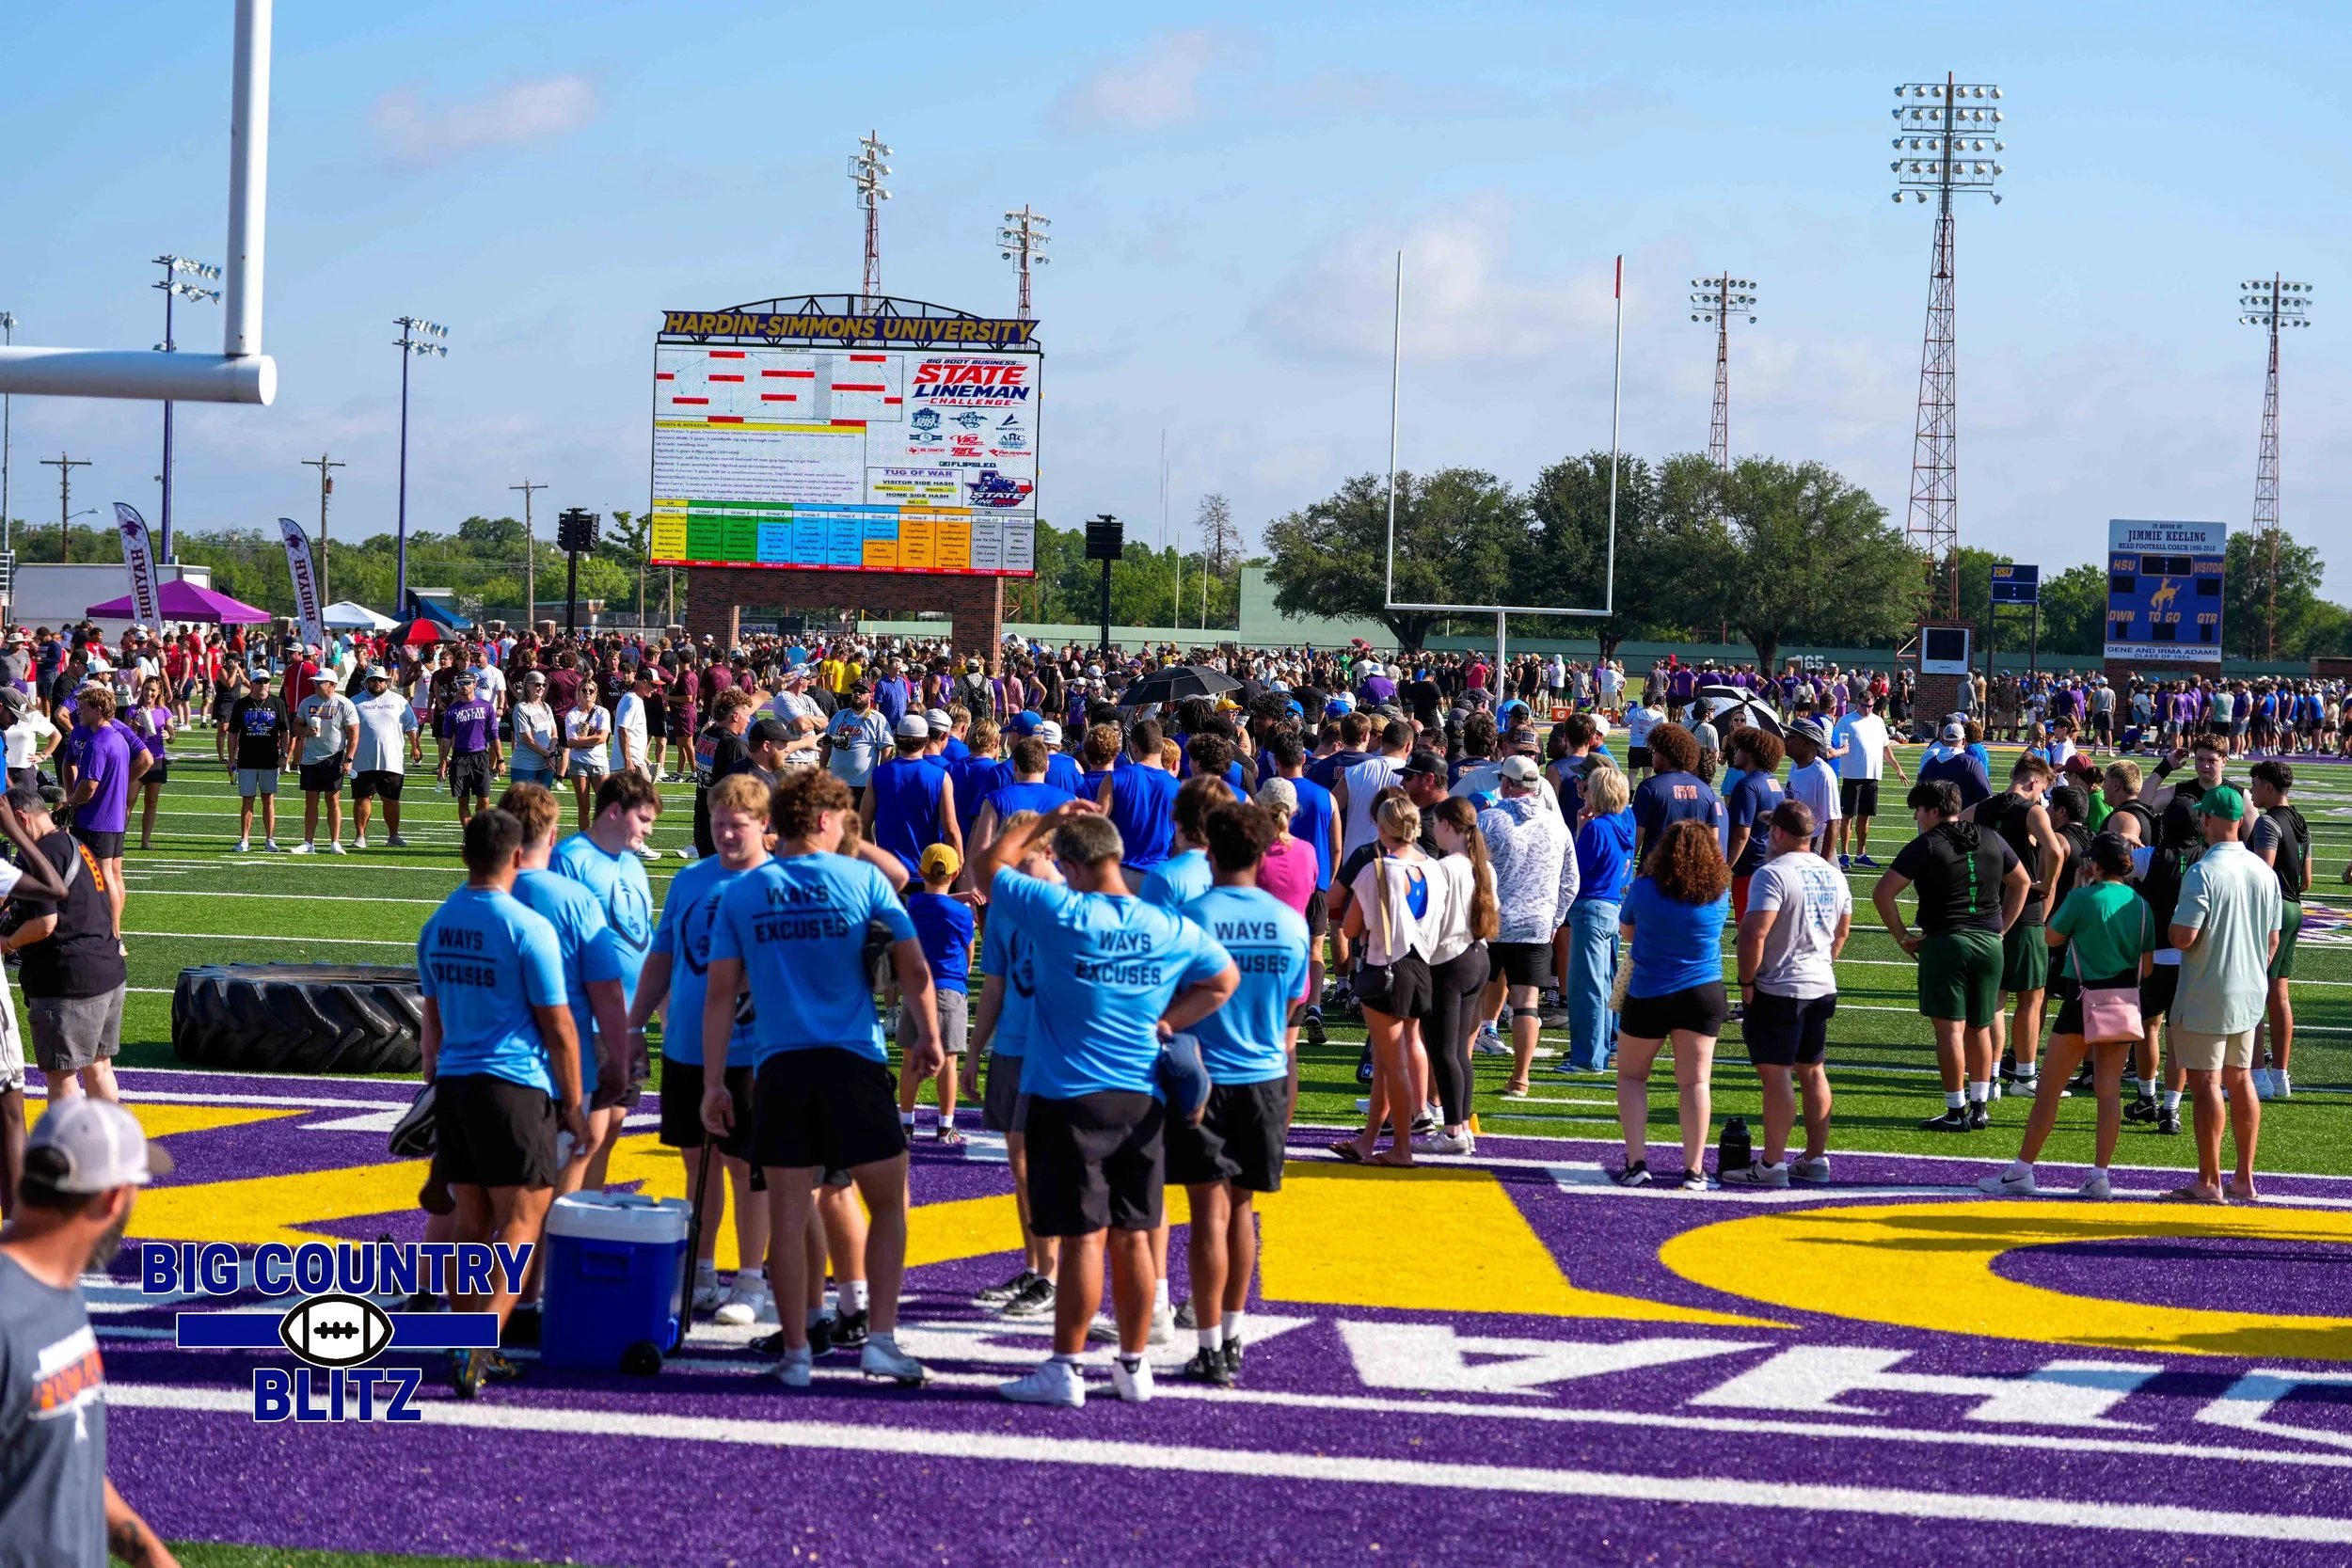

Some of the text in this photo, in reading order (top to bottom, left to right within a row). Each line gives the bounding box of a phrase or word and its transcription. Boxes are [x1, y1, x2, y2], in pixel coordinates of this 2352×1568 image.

[664, 312, 1035, 342] HARDIN-SIMMONS UNIVERSITY
[912, 364, 1028, 386] STATE
[912, 385, 1030, 401] LINEMAN
[2128, 531, 2206, 542] JIMMIE KEELING
[1994, 567, 2012, 577] HSU
[2113, 561, 2137, 571] HSU
[2194, 562, 2223, 573] VISITOR
[130, 547, 153, 619] HOOYAH
[294, 558, 316, 622] HOOYAH
[2108, 610, 2135, 621] DWN
[2148, 611, 2181, 623] TO GO
[2197, 613, 2217, 624] QTR
[1794, 655, 1825, 670] 65
[455, 712, 485, 723] FOOTBALL
[766, 885, 829, 906] WAYS
[437, 927, 484, 951] WAYS
[755, 919, 848, 943] EXCUSES
[1216, 921, 1278, 941] WAYS
[1099, 929, 1152, 953] WAYS
[1074, 961, 1161, 986] EXCUSES
